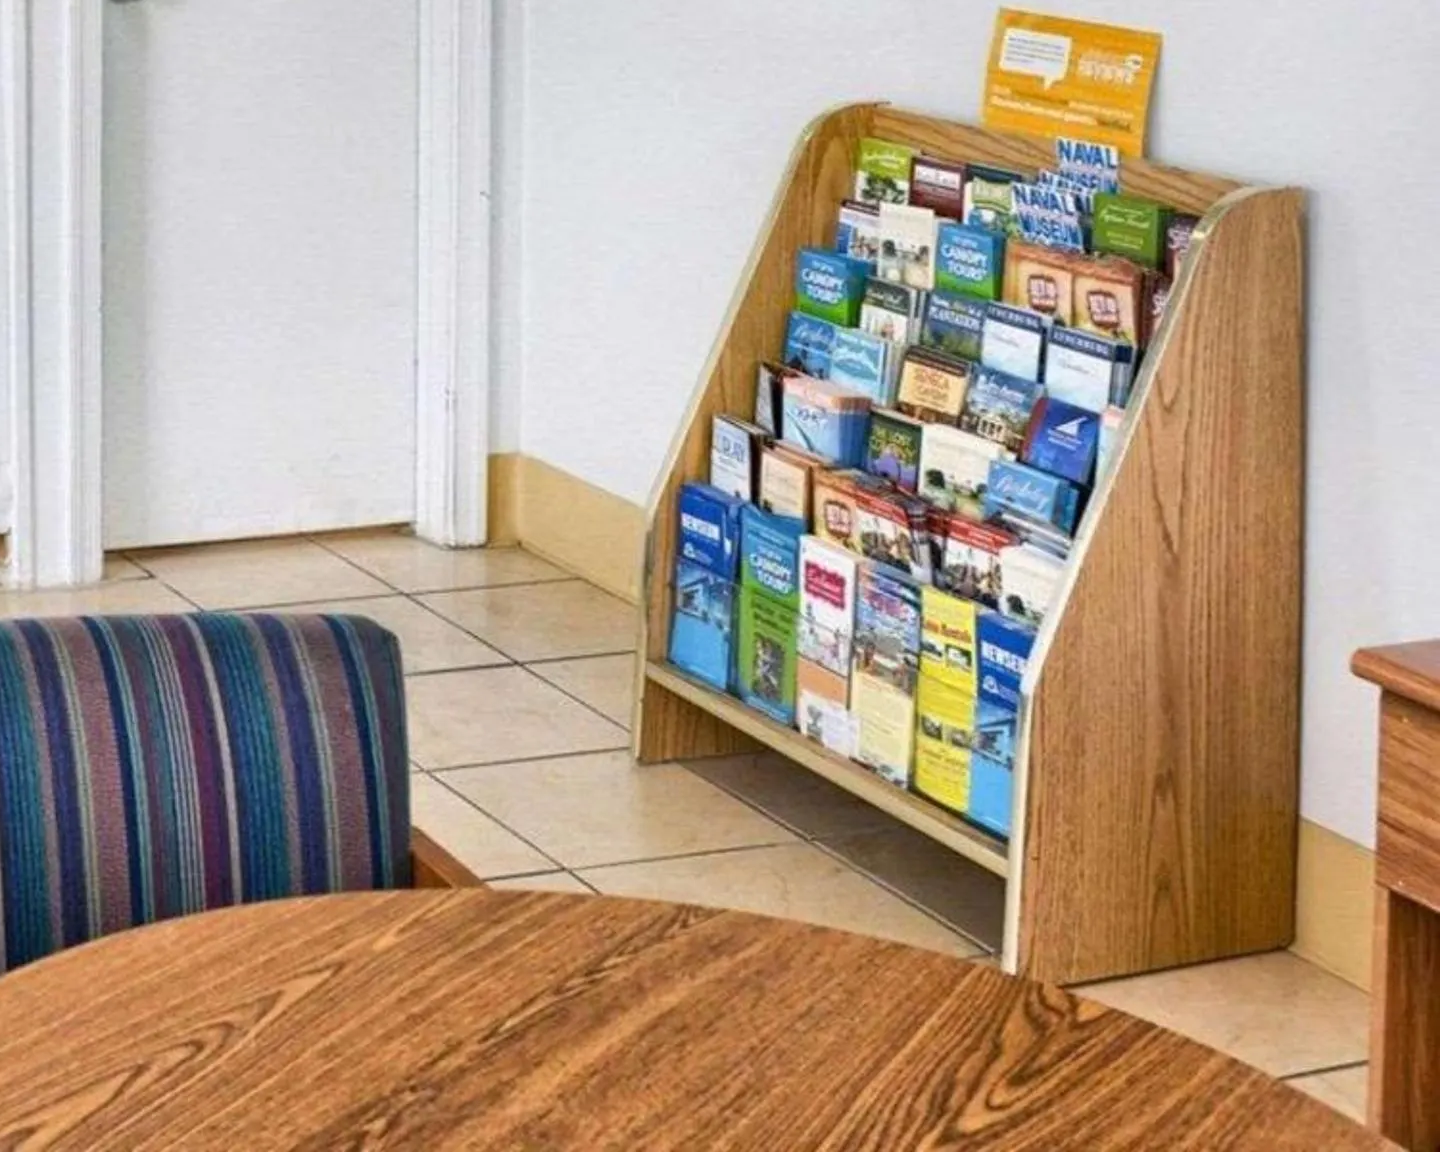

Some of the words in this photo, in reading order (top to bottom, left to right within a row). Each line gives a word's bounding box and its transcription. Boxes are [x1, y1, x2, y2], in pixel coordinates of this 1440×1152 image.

[1058, 138, 1117, 169] NAVAL
[1013, 184, 1076, 216] NAVAL
[1019, 211, 1081, 245] MUSEUM
[942, 243, 988, 268] CANOPY
[802, 267, 843, 291] CANOPY
